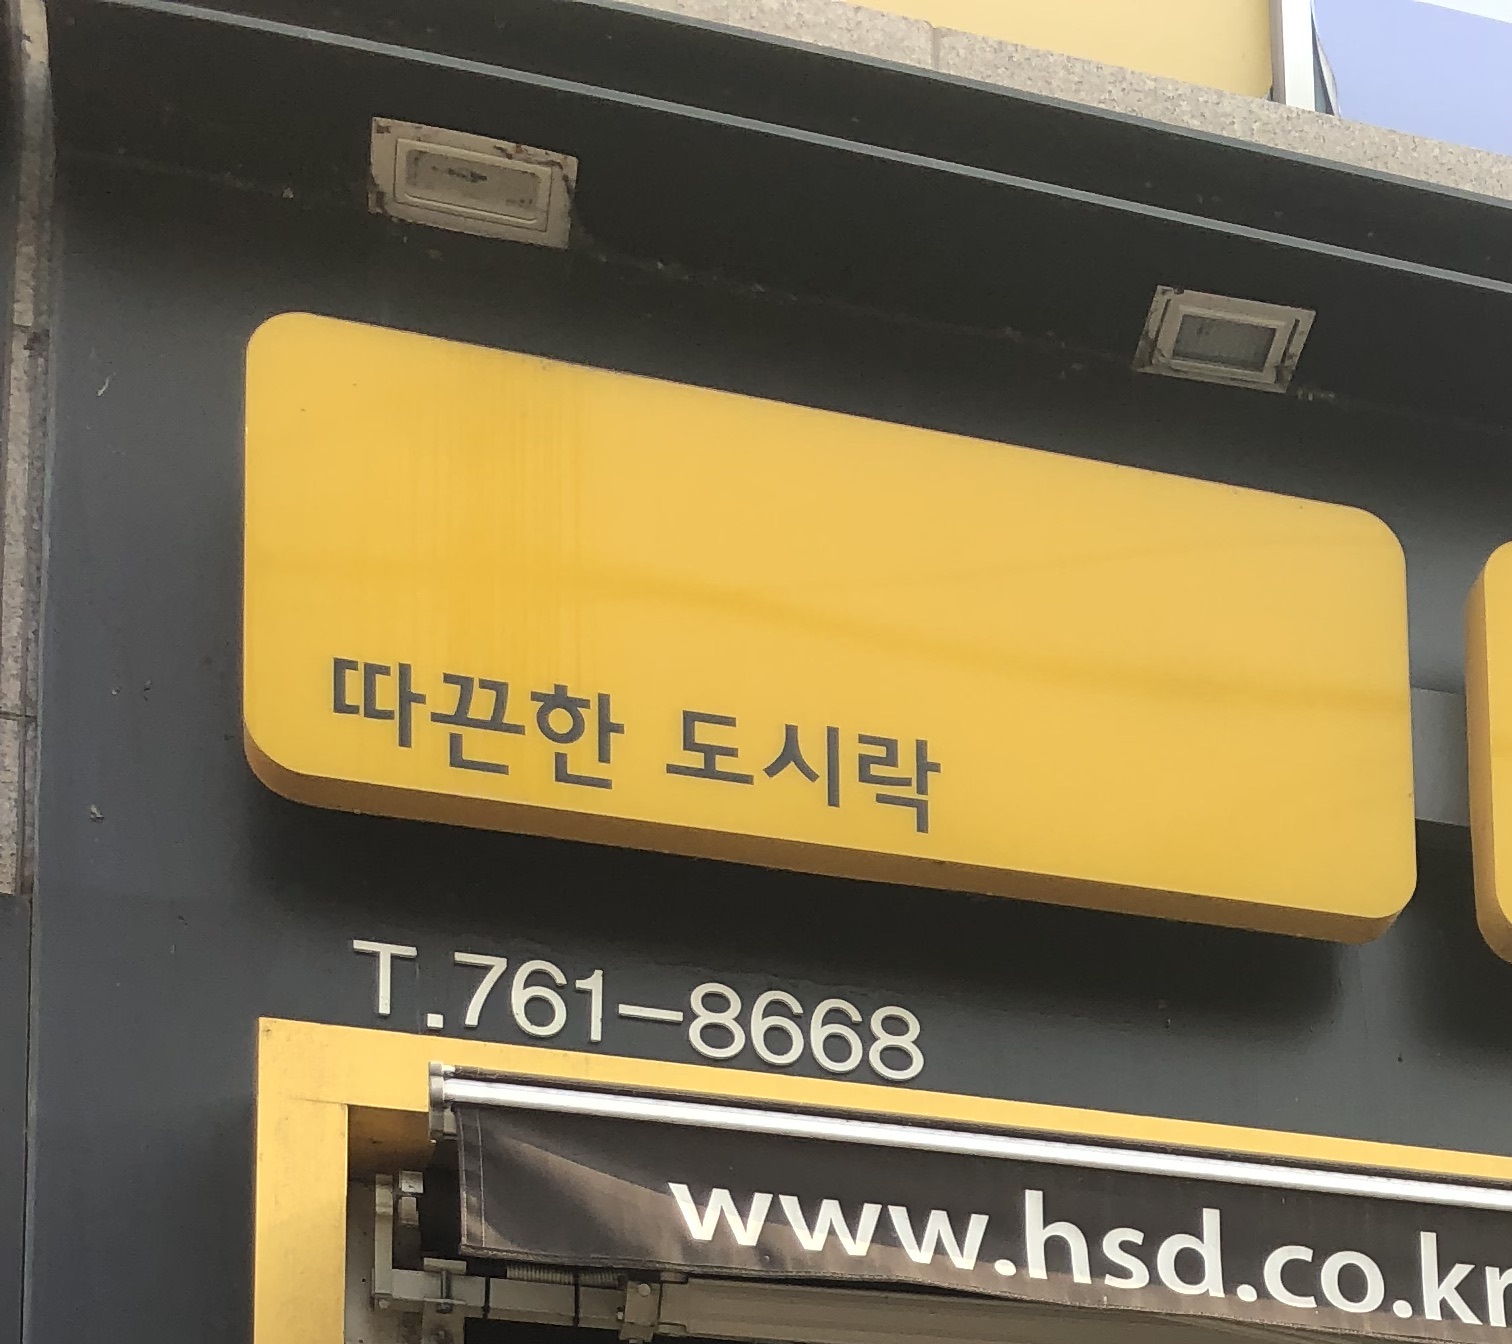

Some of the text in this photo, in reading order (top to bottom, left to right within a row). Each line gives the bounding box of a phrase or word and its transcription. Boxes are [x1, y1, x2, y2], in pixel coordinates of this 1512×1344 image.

[333, 658, 941, 833] 따끈한 도시락
[353, 940, 925, 1082] T.761-8668
